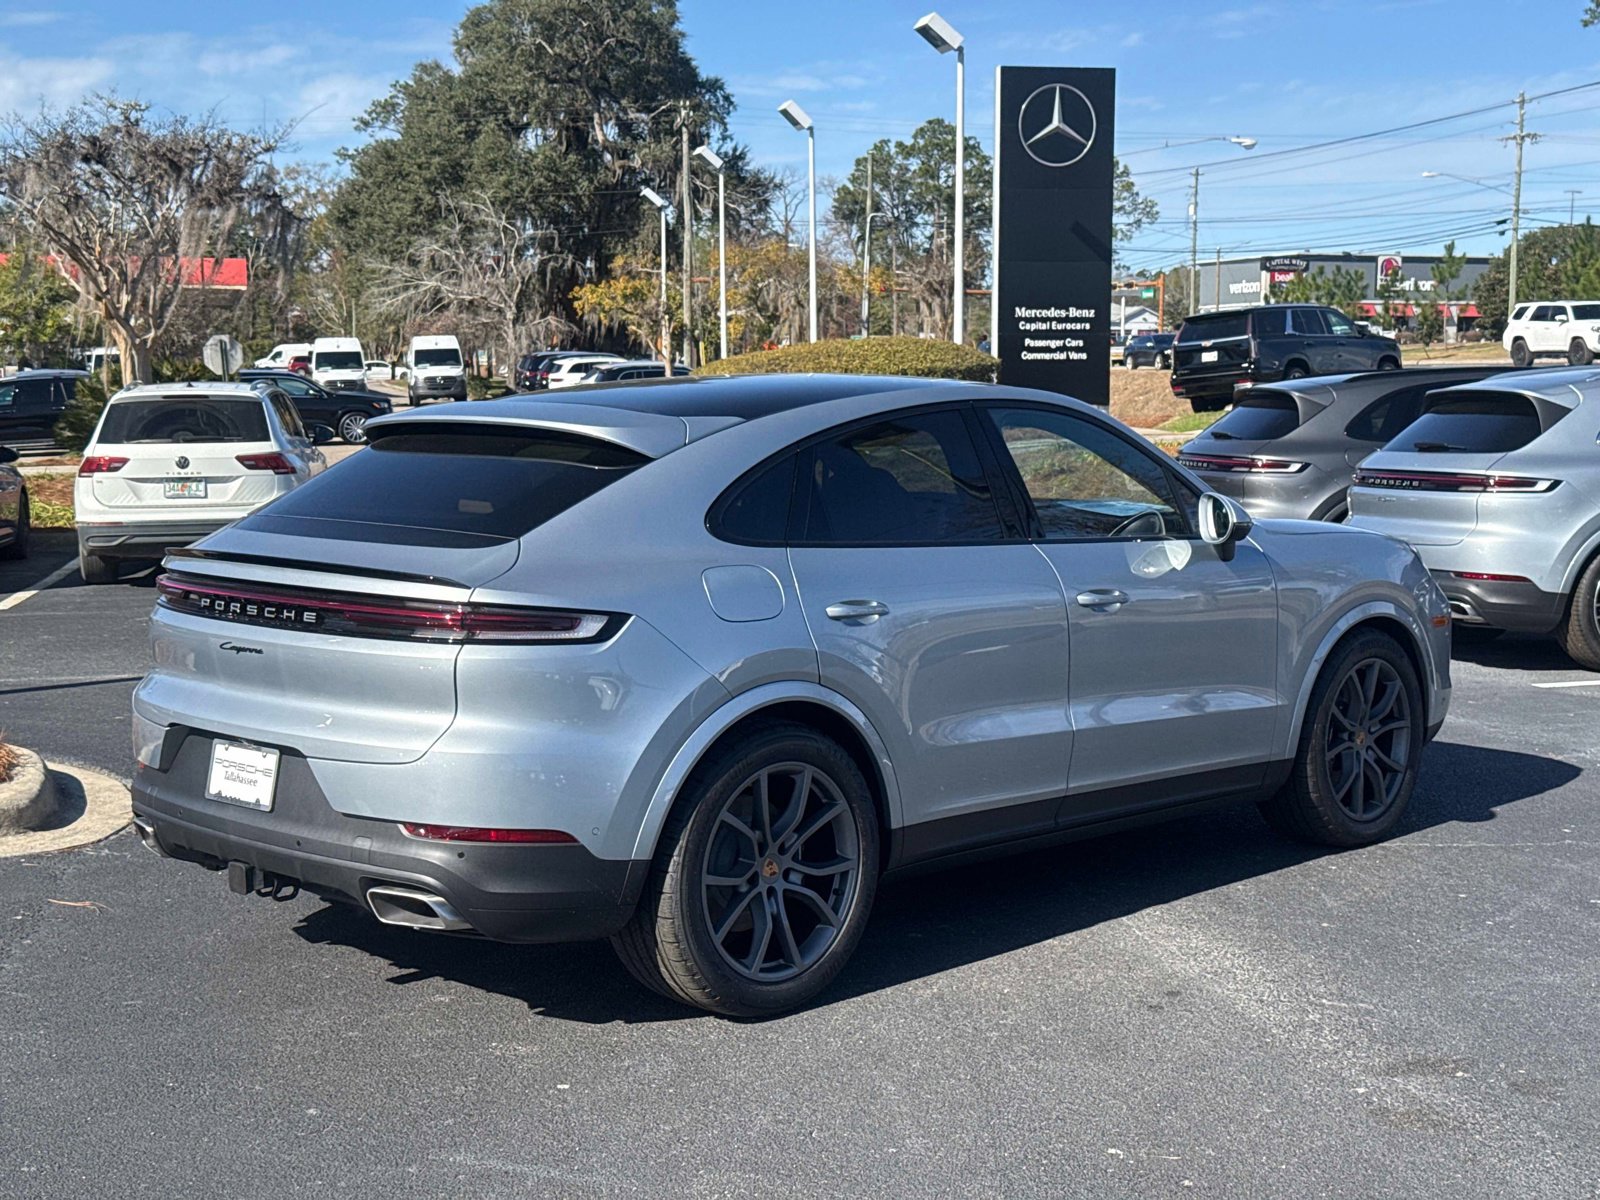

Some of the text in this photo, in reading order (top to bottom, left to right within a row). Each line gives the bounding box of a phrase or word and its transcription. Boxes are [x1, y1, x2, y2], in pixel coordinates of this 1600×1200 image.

[1229, 280, 1260, 294] verizon
[1014, 306, 1095, 318] Mercedes-Benz
[1018, 321, 1091, 331] Capital Eurocars
[1024, 338, 1084, 349] Passenger Cars
[1021, 351, 1087, 360] Commercial Vans
[1368, 478, 1419, 487] PORSCHE
[200, 597, 317, 623] PORSCHE
[219, 641, 264, 655] Cayenne
[214, 757, 273, 778] PORSCHE
[223, 770, 258, 787] Tallahassee
